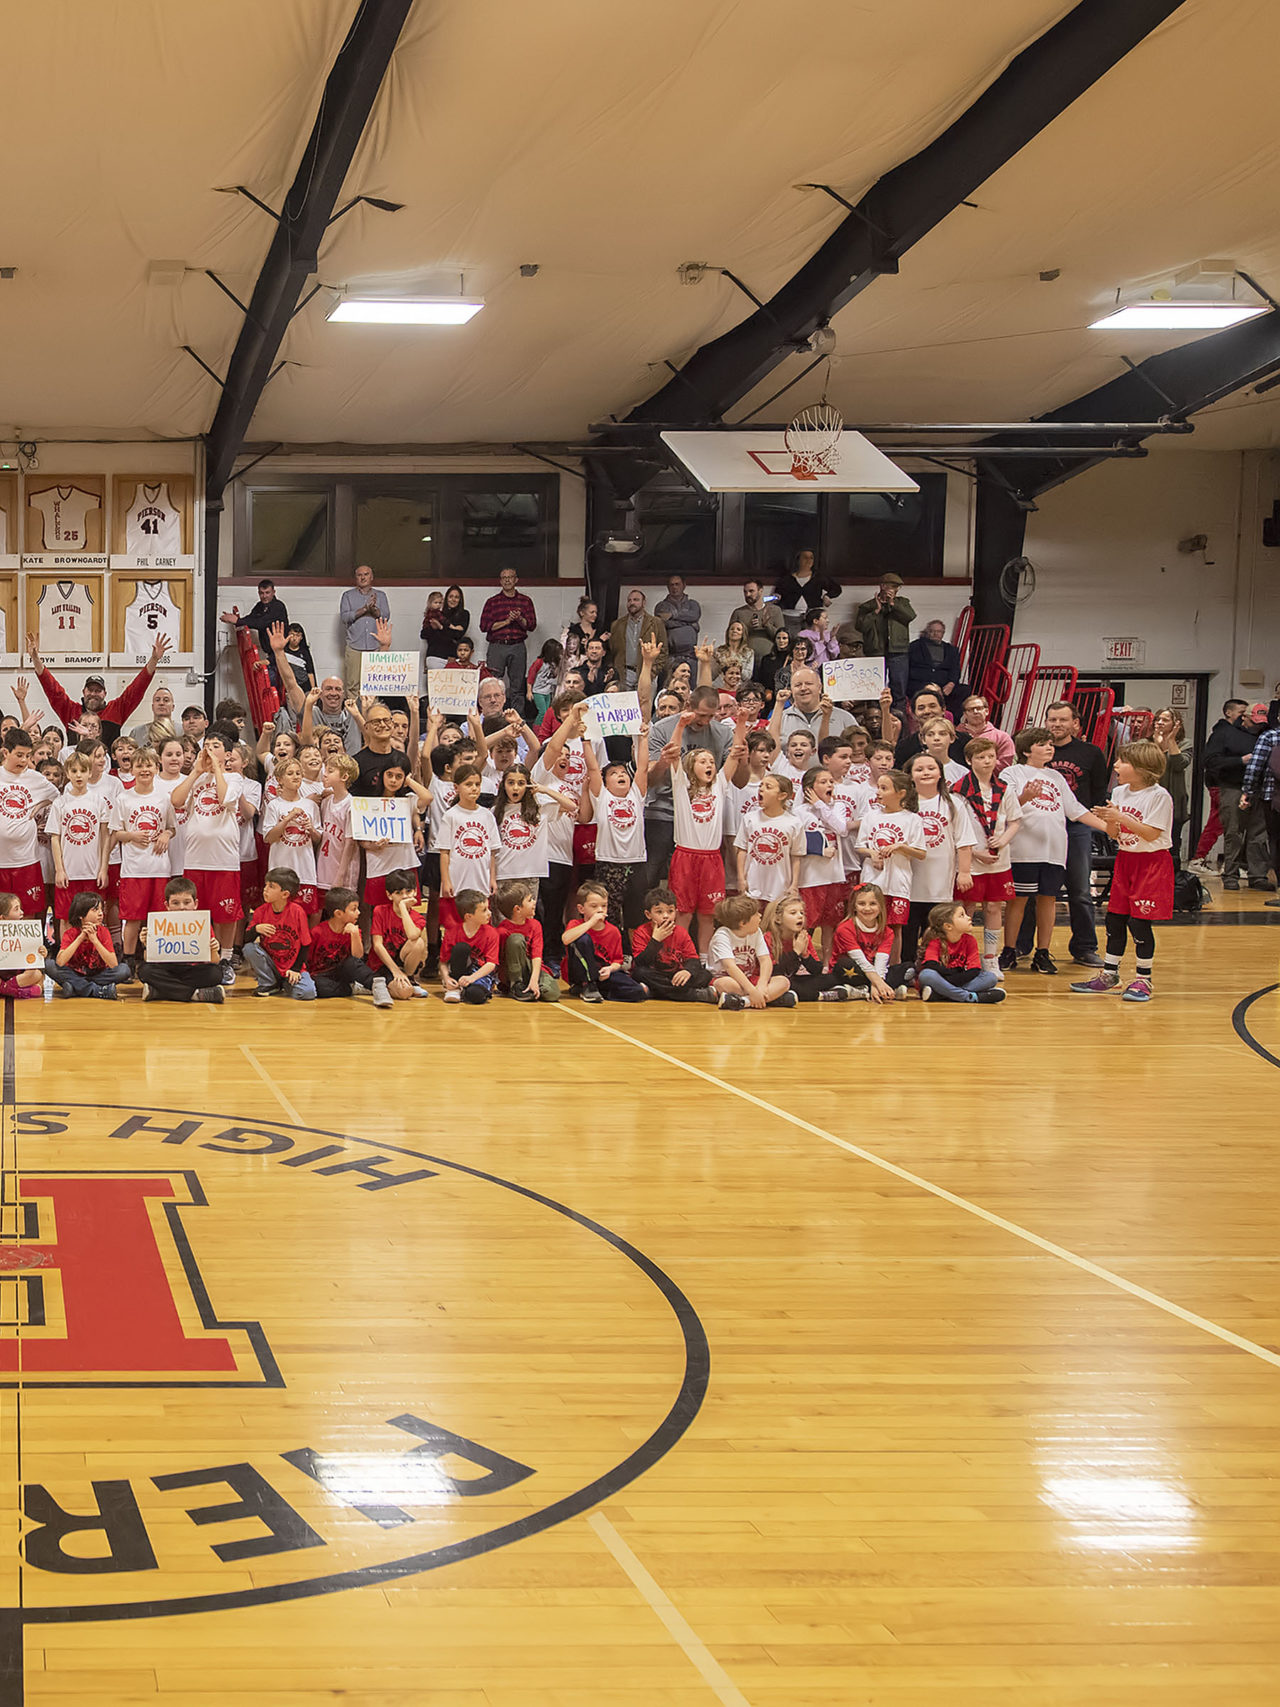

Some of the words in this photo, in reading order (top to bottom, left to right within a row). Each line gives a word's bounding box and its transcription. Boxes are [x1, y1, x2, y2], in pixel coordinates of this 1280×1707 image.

[137, 506, 166, 522] PIERSON
[140, 518, 159, 534] 41
[63, 530, 79, 541] 25
[137, 557, 149, 567] PHIL
[155, 557, 176, 567] CARNEY
[138, 602, 168, 618] PIERSON
[58, 616, 76, 629] 11
[146, 614, 158, 630] 5
[1113, 642, 1132, 656] EXIT
[135, 655, 147, 664] BOB
[824, 659, 854, 675] SAG
[367, 673, 407, 684] PROPERTY
[362, 684, 417, 693] MANAGEMENT
[596, 707, 640, 722] HARBOR
[10, 785, 33, 803] HARBOR
[194, 786, 205, 798] SAG
[193, 804, 210, 816] YOUTH
[740, 800, 751, 814] SAG
[62, 813, 72, 826] SAG
[72, 808, 98, 825] HARBOR
[129, 811, 139, 824] SAG
[323, 821, 344, 841] YAL
[362, 816, 407, 841] MOTT
[455, 826, 465, 839] SAG
[878, 822, 905, 842] HARBOR
[63, 833, 81, 845] YOUTH
[82, 831, 97, 845] HOOP
[501, 838, 520, 850] YOUTH
[522, 835, 537, 850] HOOP
[748, 830, 760, 843] SAG
[761, 827, 788, 847] HARBOR
[322, 840, 330, 856] 4
[455, 845, 473, 859] YOUTH
[750, 850, 767, 865] YOUTH
[768, 853, 784, 865] HOOP
[154, 918, 206, 937] MALLOY
[1, 938, 22, 953] CPA
[155, 937, 200, 955] POOLS
[108, 1114, 440, 1192] HIGH
